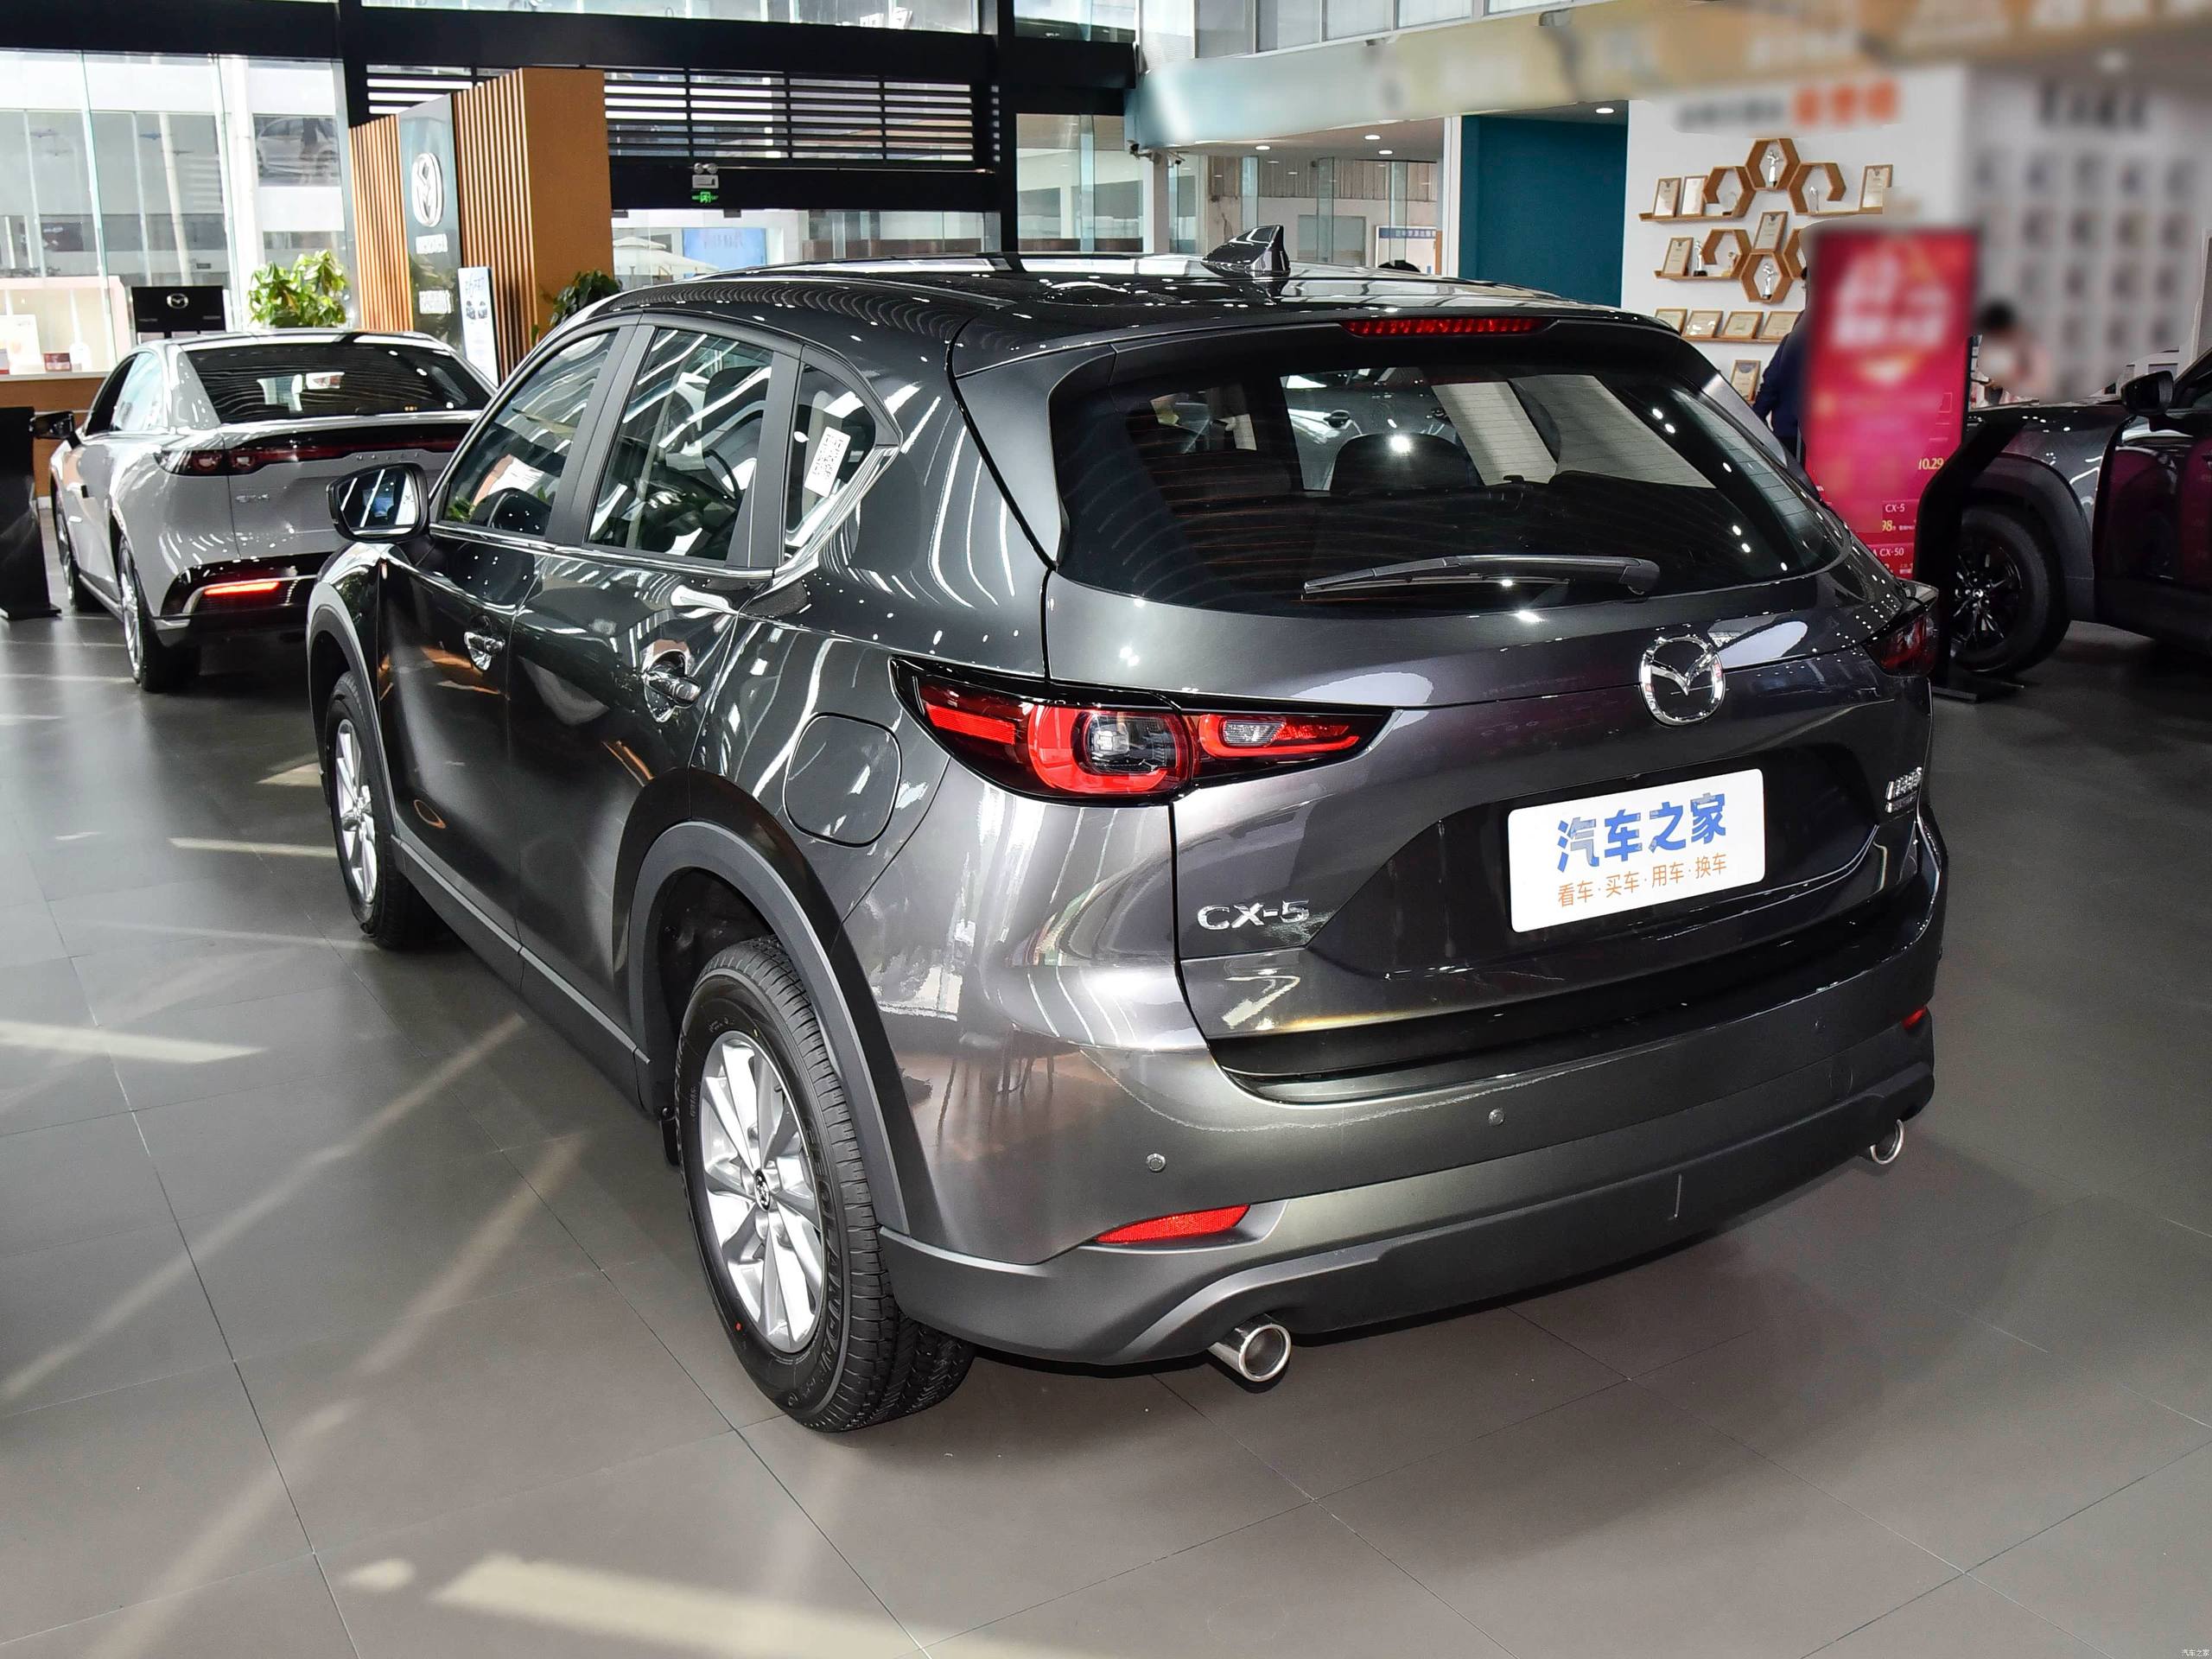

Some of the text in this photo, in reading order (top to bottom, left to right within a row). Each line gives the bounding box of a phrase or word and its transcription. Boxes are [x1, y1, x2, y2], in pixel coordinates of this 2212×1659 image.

[1885, 503, 1906, 513] CX-5
[1879, 547, 1904, 557] CX-50
[1556, 791, 1726, 874] 汽车之家
[1197, 899, 1310, 931] CX-5
